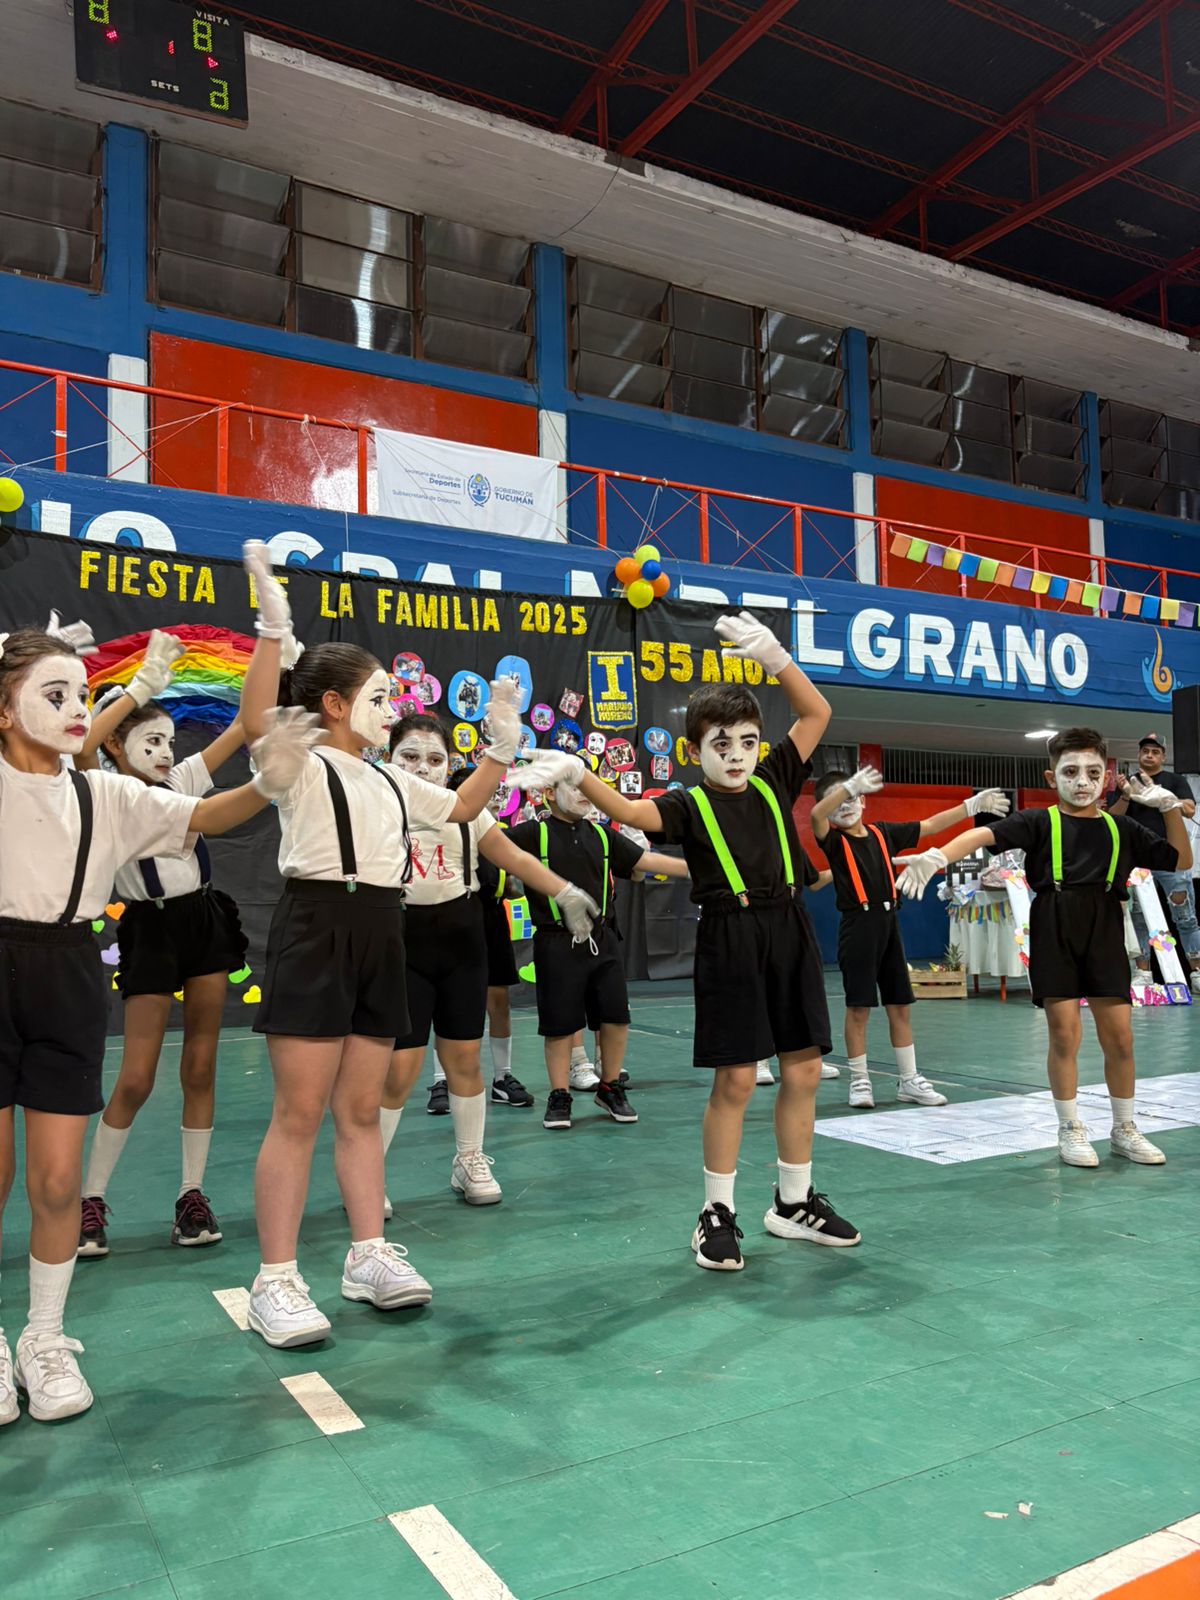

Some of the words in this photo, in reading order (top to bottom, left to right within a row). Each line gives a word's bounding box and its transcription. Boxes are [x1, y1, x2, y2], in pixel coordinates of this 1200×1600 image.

[195, 10, 230, 26] VISITA
[192, 18, 212, 53] 8
[151, 79, 180, 93] SETS
[429, 477, 461, 489] Deportes
[494, 486, 525, 496] GOBIERNO
[80, 550, 215, 604] FIESTA
[320, 581, 354, 619] LA
[377, 588, 500, 633] FAMILIA
[519, 601, 588, 635] 2025
[640, 641, 694, 682] 55
[701, 639, 780, 685] AÑO
